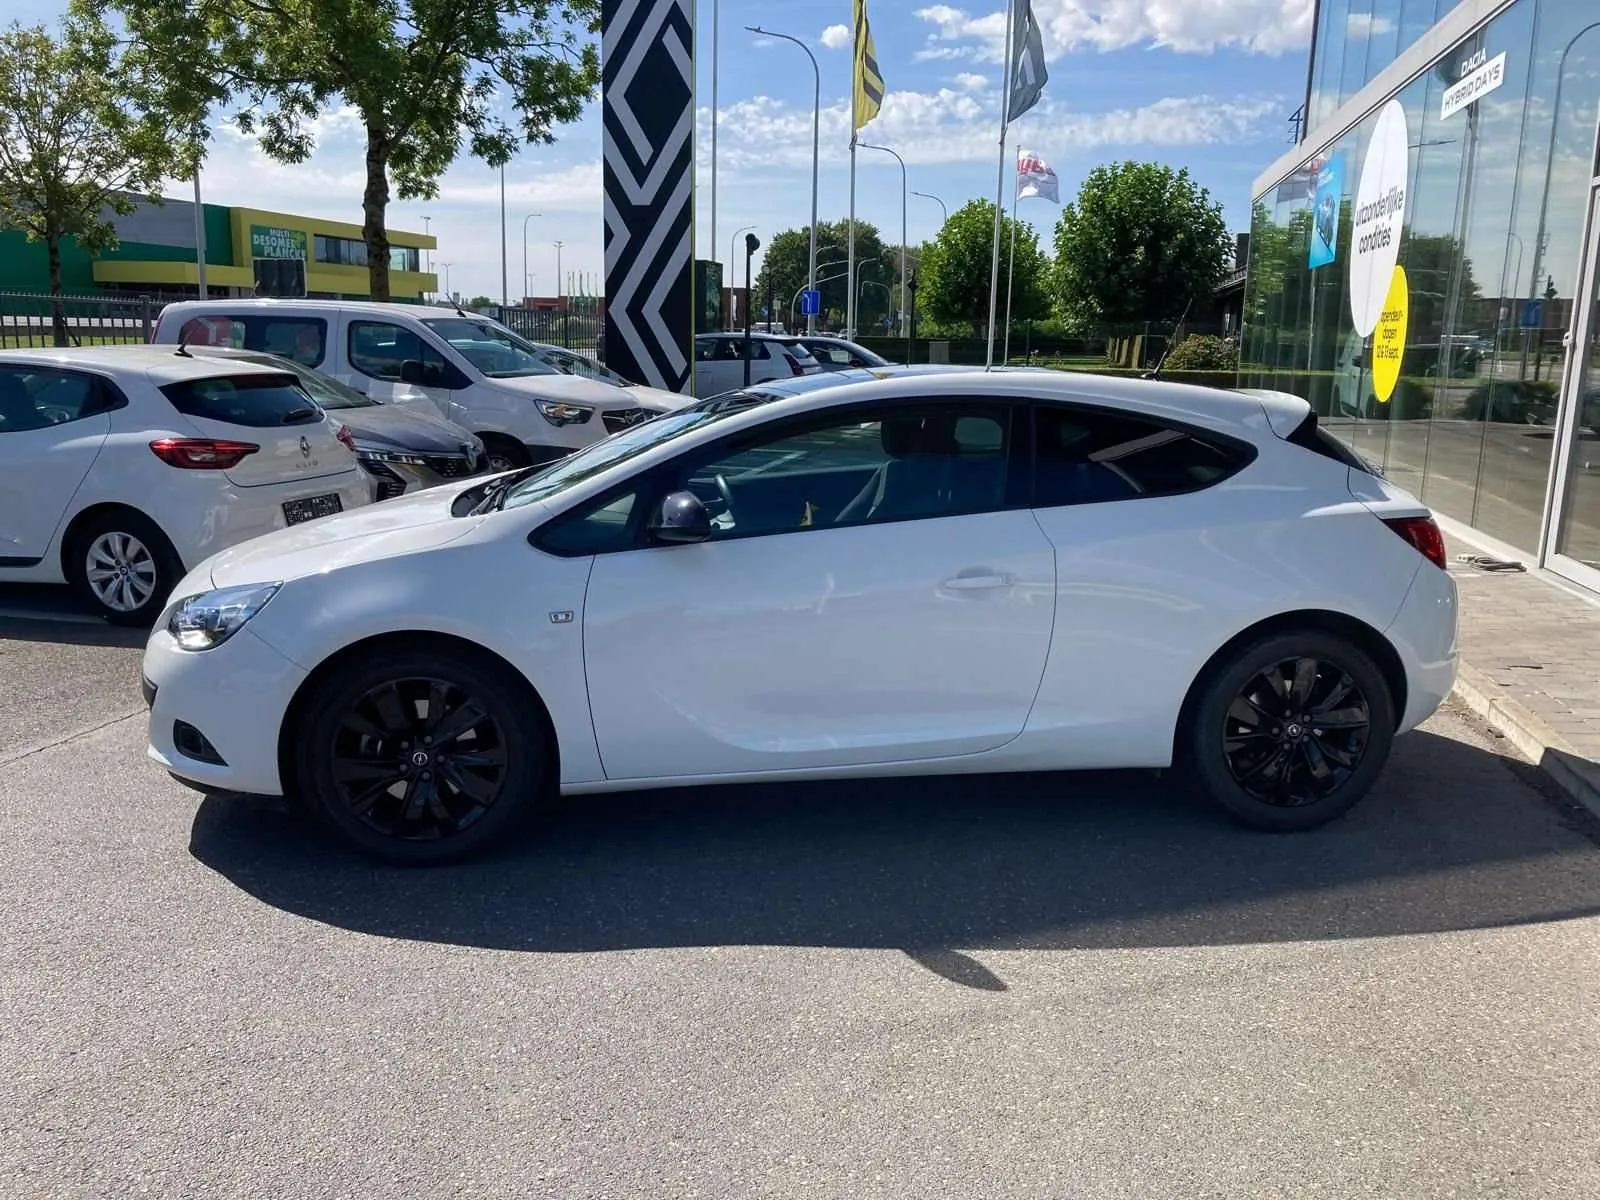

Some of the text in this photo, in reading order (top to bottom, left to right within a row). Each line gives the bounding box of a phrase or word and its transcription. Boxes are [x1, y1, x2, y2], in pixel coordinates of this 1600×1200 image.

[1461, 47, 1487, 77] DACIA
[1445, 63, 1501, 112] HYBRID DAYS
[1356, 186, 1404, 227] uitzonderlijke
[1359, 222, 1392, 254] condities
